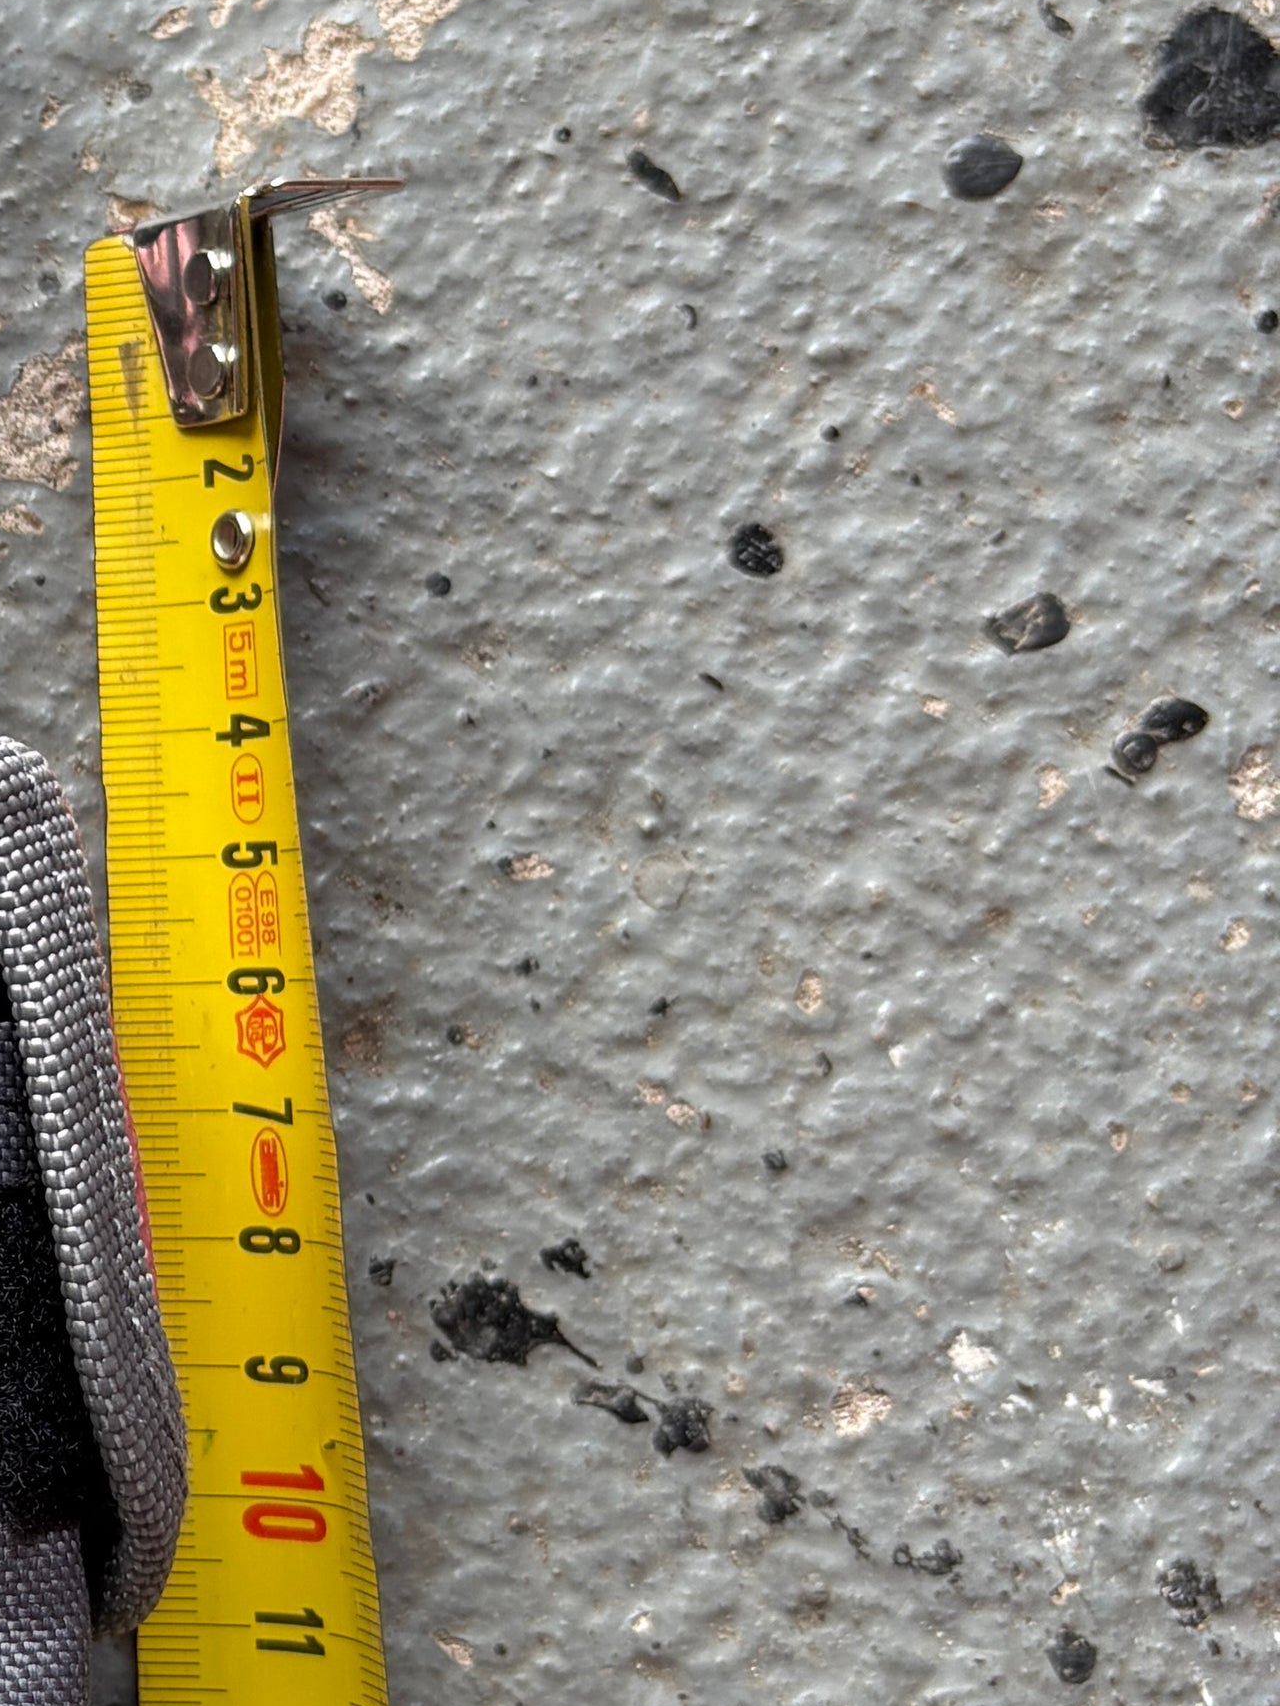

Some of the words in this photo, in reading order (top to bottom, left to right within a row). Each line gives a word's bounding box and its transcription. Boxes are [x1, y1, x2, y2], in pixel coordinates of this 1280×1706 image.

[203, 454, 254, 487] 2
[209, 583, 262, 615] 3
[216, 714, 270, 747] 4
[221, 841, 278, 869] 5
[235, 886, 256, 957] 01001
[227, 967, 285, 995] 6
[232, 1097, 293, 1125] 7
[239, 1226, 301, 1255] 8
[244, 1355, 309, 1385] 9
[241, 1464, 327, 1543] 10
[254, 1607, 325, 1656] 11
